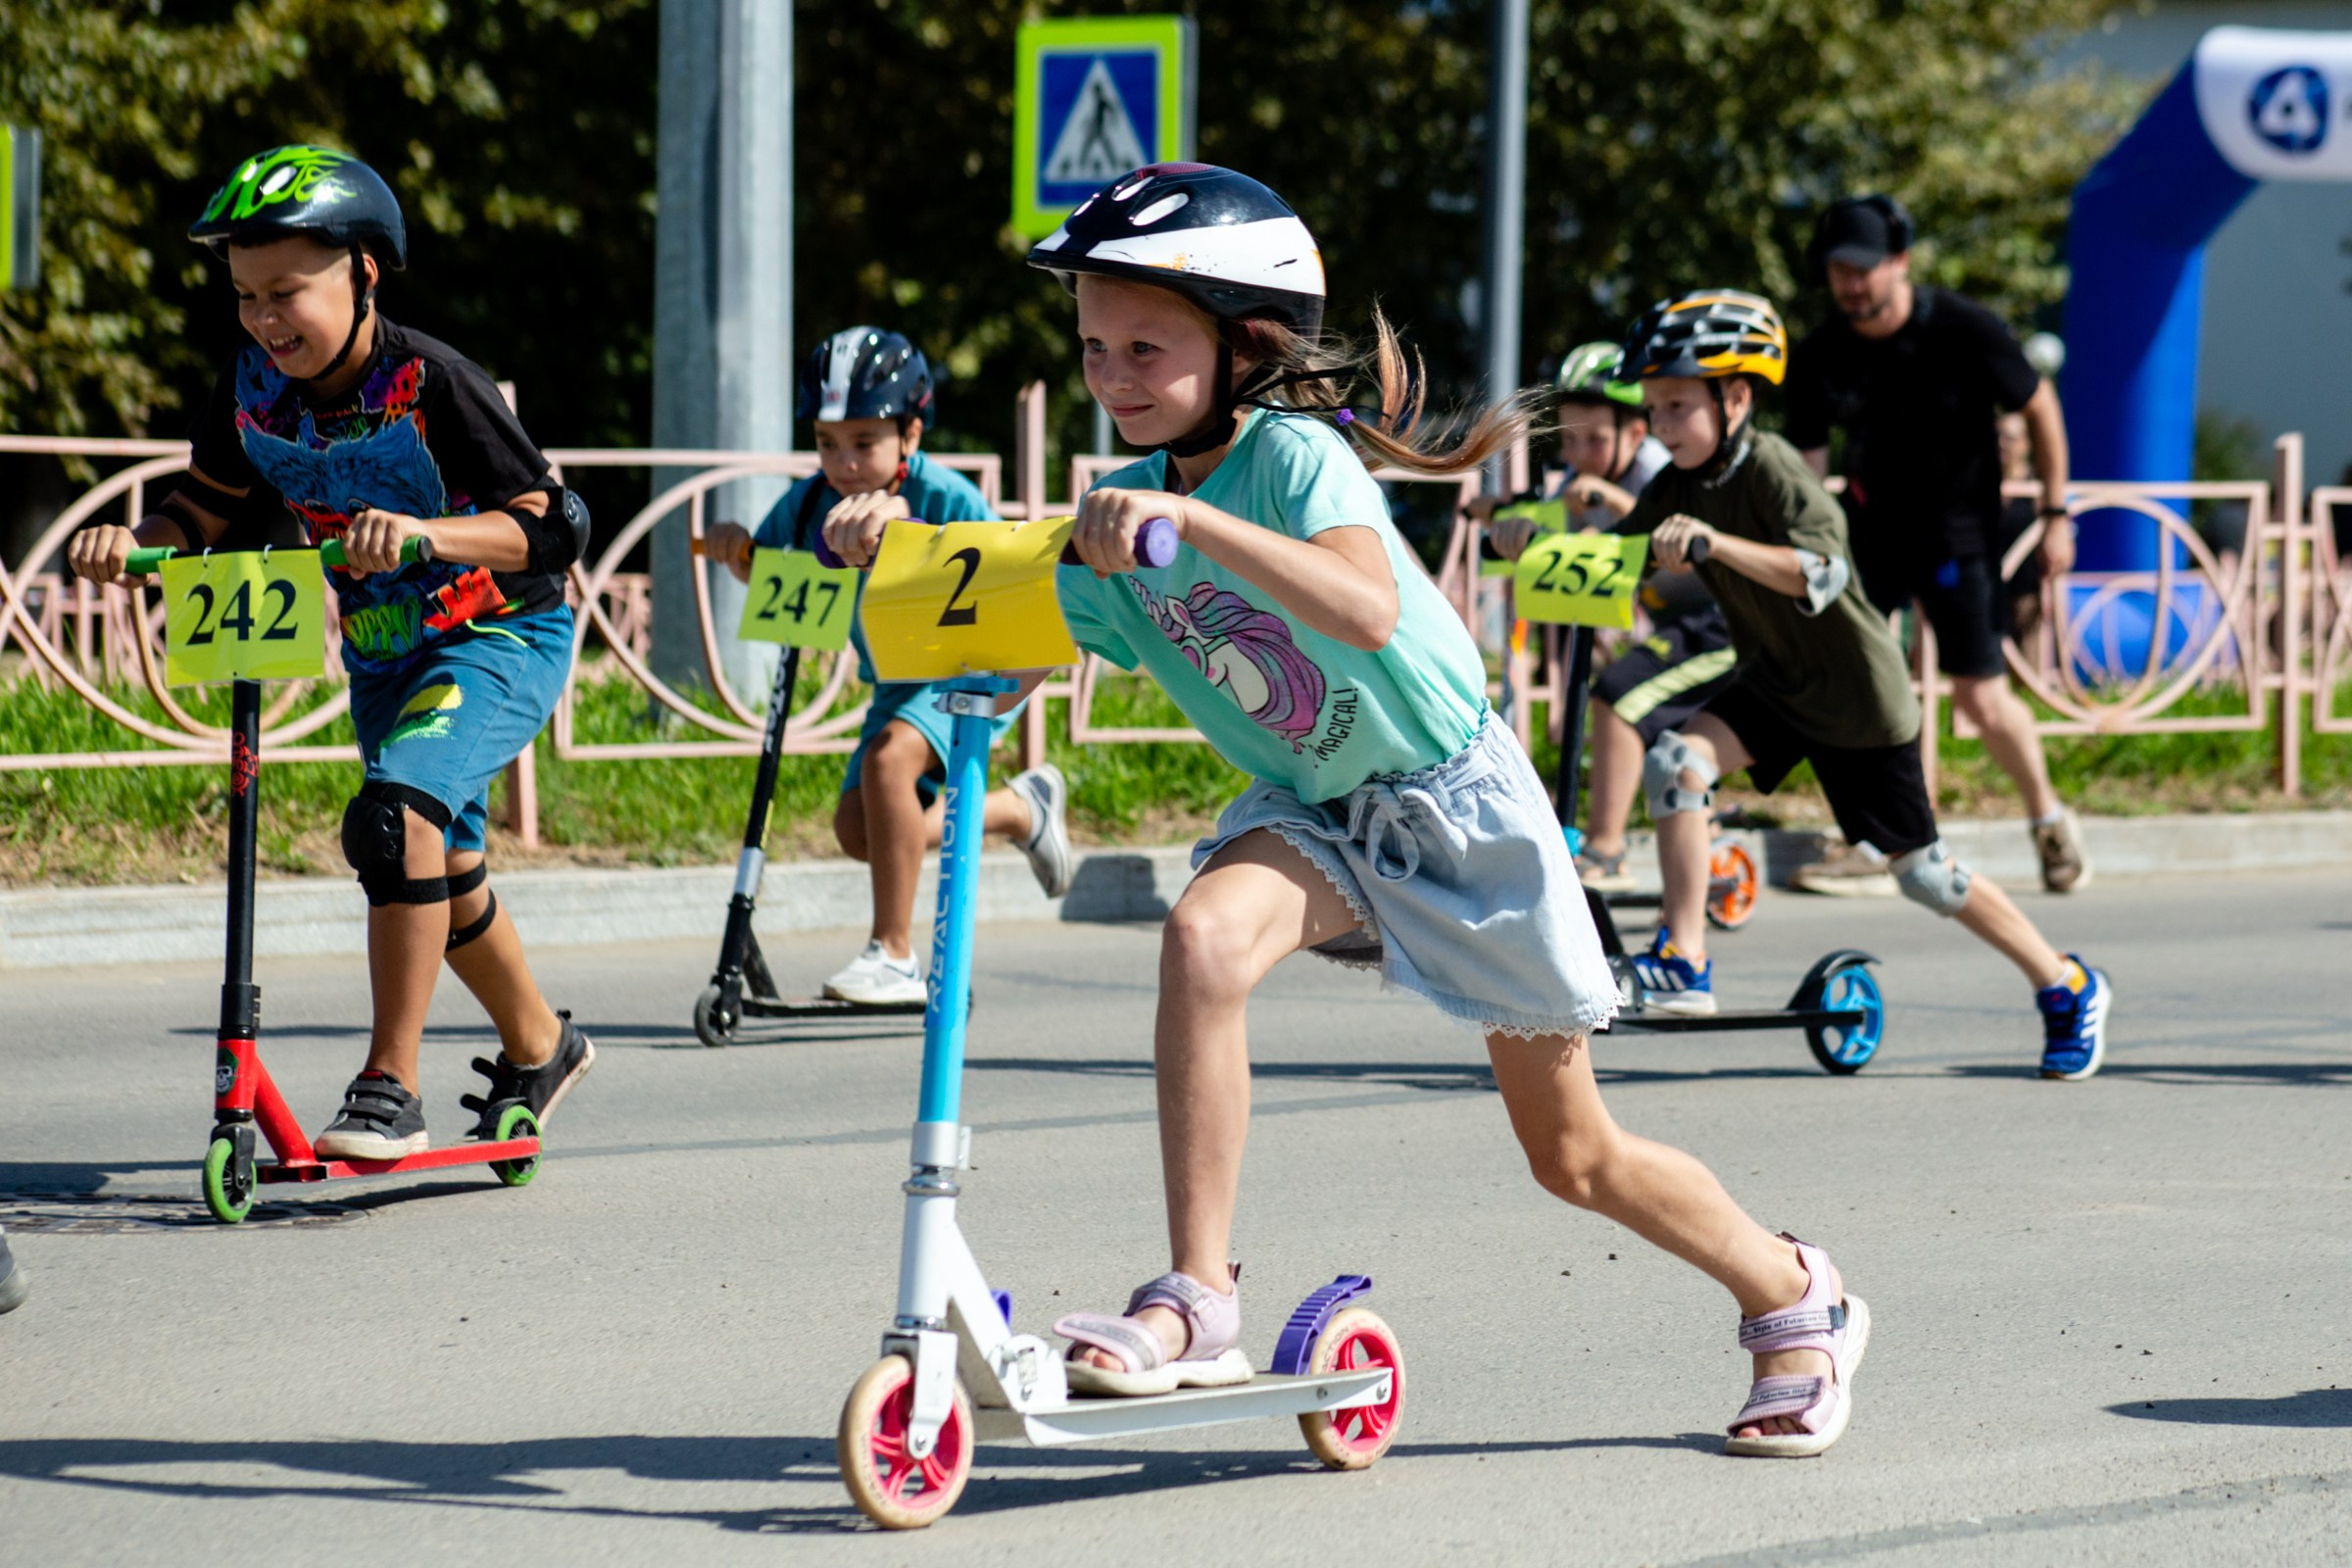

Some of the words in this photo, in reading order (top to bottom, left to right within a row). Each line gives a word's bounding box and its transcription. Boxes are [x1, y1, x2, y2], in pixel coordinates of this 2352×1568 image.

[756, 574, 841, 628] 247
[936, 546, 982, 627] 2
[1531, 550, 1624, 599] 252
[185, 578, 298, 646] 242
[1314, 687, 1359, 761] MAGICAL!
[926, 787, 959, 1013] REACTION
